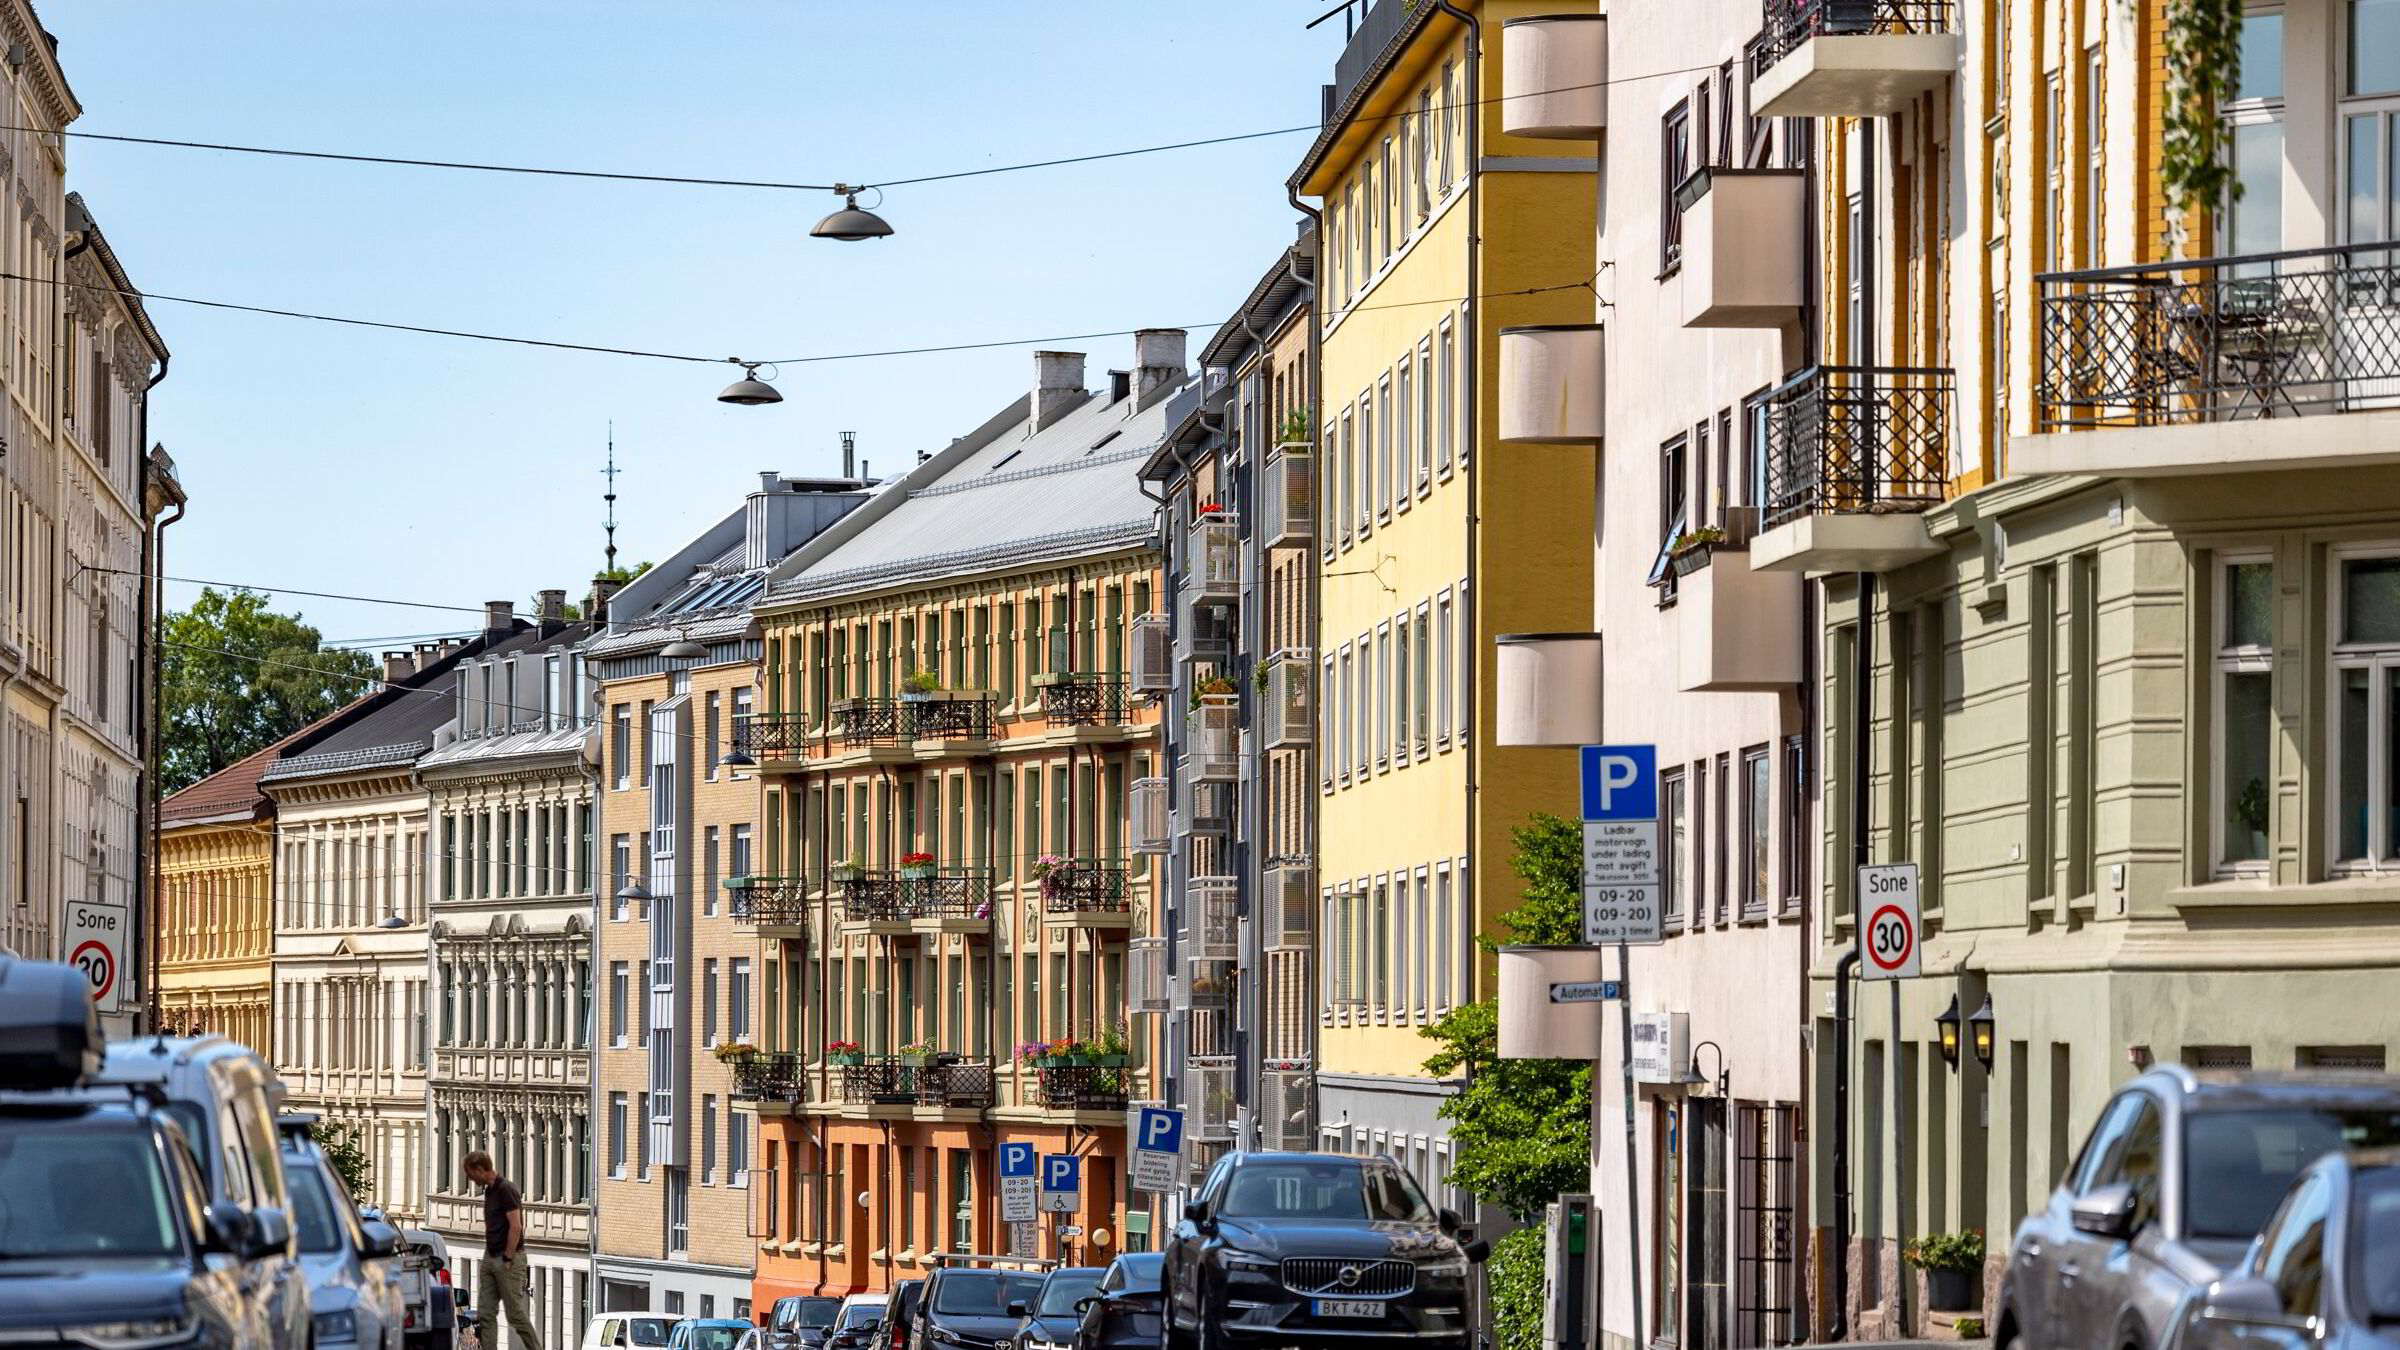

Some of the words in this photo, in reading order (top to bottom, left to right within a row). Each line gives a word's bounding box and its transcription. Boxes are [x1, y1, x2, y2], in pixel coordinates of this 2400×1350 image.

[1600, 755, 1638, 811] P
[1603, 826, 1636, 835] Ladbar
[1595, 839, 1647, 848] motorvogn
[1591, 850, 1618, 859] under
[1623, 849, 1651, 860] lading
[1595, 862, 1614, 871] mot
[1619, 861, 1647, 873] avgift
[1869, 873, 1908, 894] Sone
[76, 908, 116, 931] Sone
[1592, 927, 1617, 936] Maks
[1621, 926, 1627, 936] 3
[1630, 926, 1653, 936] timer
[1876, 922, 1905, 954] 30
[1560, 986, 1602, 999] Automat
[1148, 1113, 1172, 1145] P
[1008, 1147, 1025, 1172] P
[1143, 1160, 1168, 1169] bildeling
[1051, 1160, 1070, 1187] P
[1323, 1302, 1349, 1315] BKT
